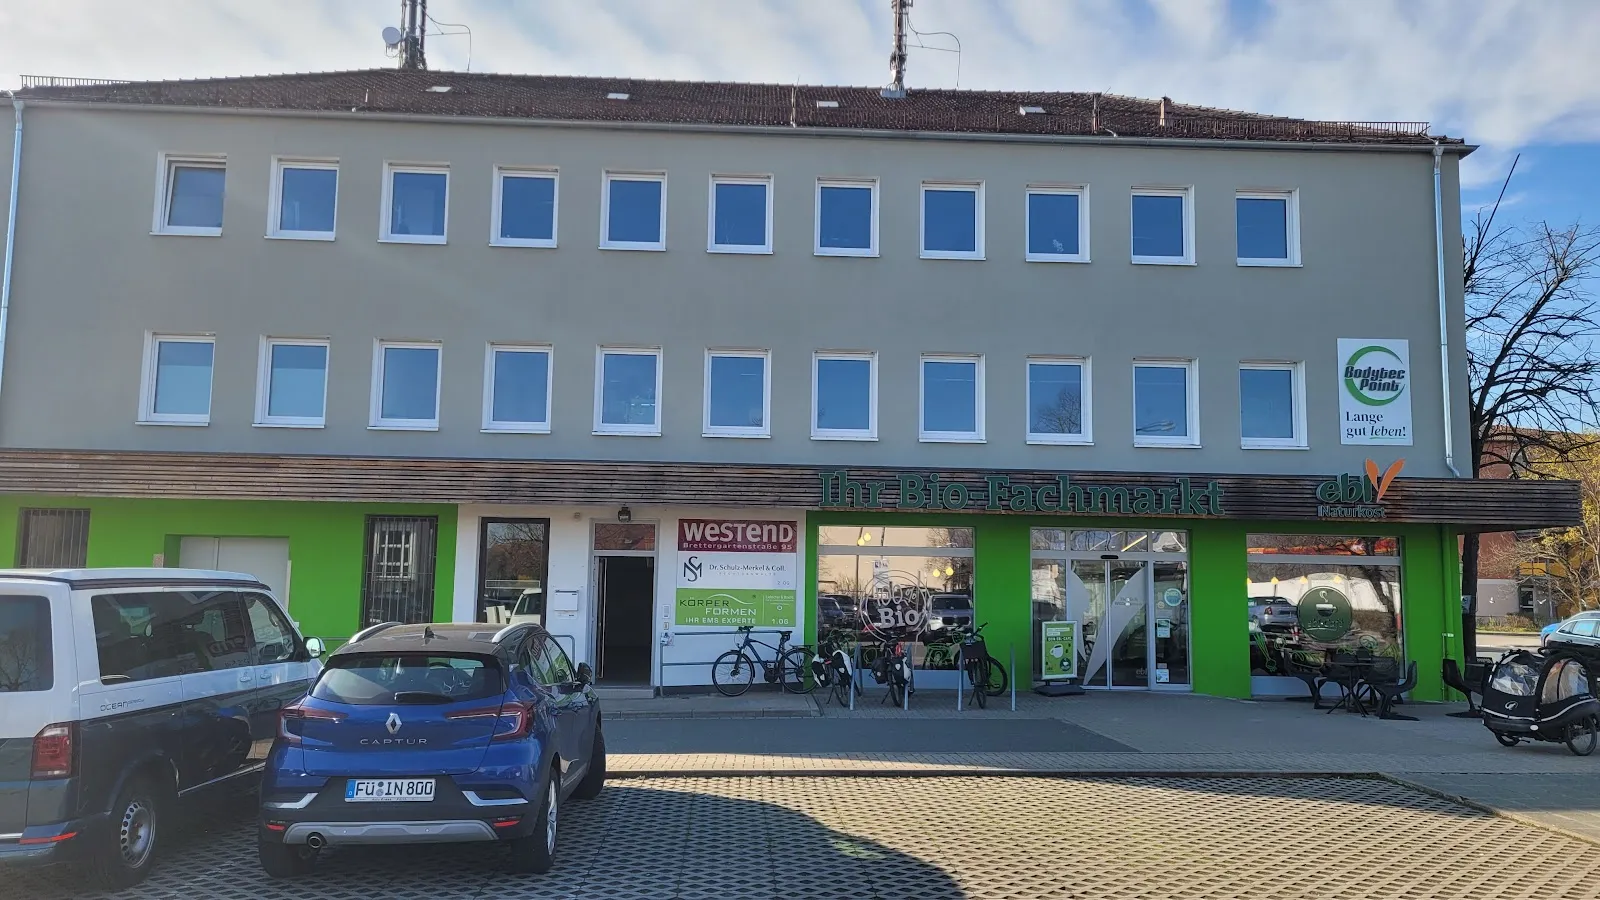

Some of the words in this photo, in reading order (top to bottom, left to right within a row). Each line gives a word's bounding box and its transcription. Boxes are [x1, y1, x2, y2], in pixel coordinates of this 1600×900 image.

[1344, 365, 1405, 381] Bodytec
[1359, 379, 1401, 392] Point
[1346, 411, 1384, 427] Lange
[1346, 427, 1366, 439] gut
[1370, 426, 1406, 437] leben!
[818, 471, 885, 508] Ihr
[896, 472, 1226, 515] Bio-Fachmarkt
[1316, 473, 1373, 504] ebl
[1318, 505, 1386, 518] Naturkost
[683, 542, 778, 550] Brettergartenstraße
[680, 597, 730, 606] KÖRPER
[705, 608, 757, 616] FORMEN
[878, 605, 920, 628] Bio
[356, 781, 375, 796] FÜ
[385, 781, 403, 796] IN
[406, 781, 433, 796] 800
